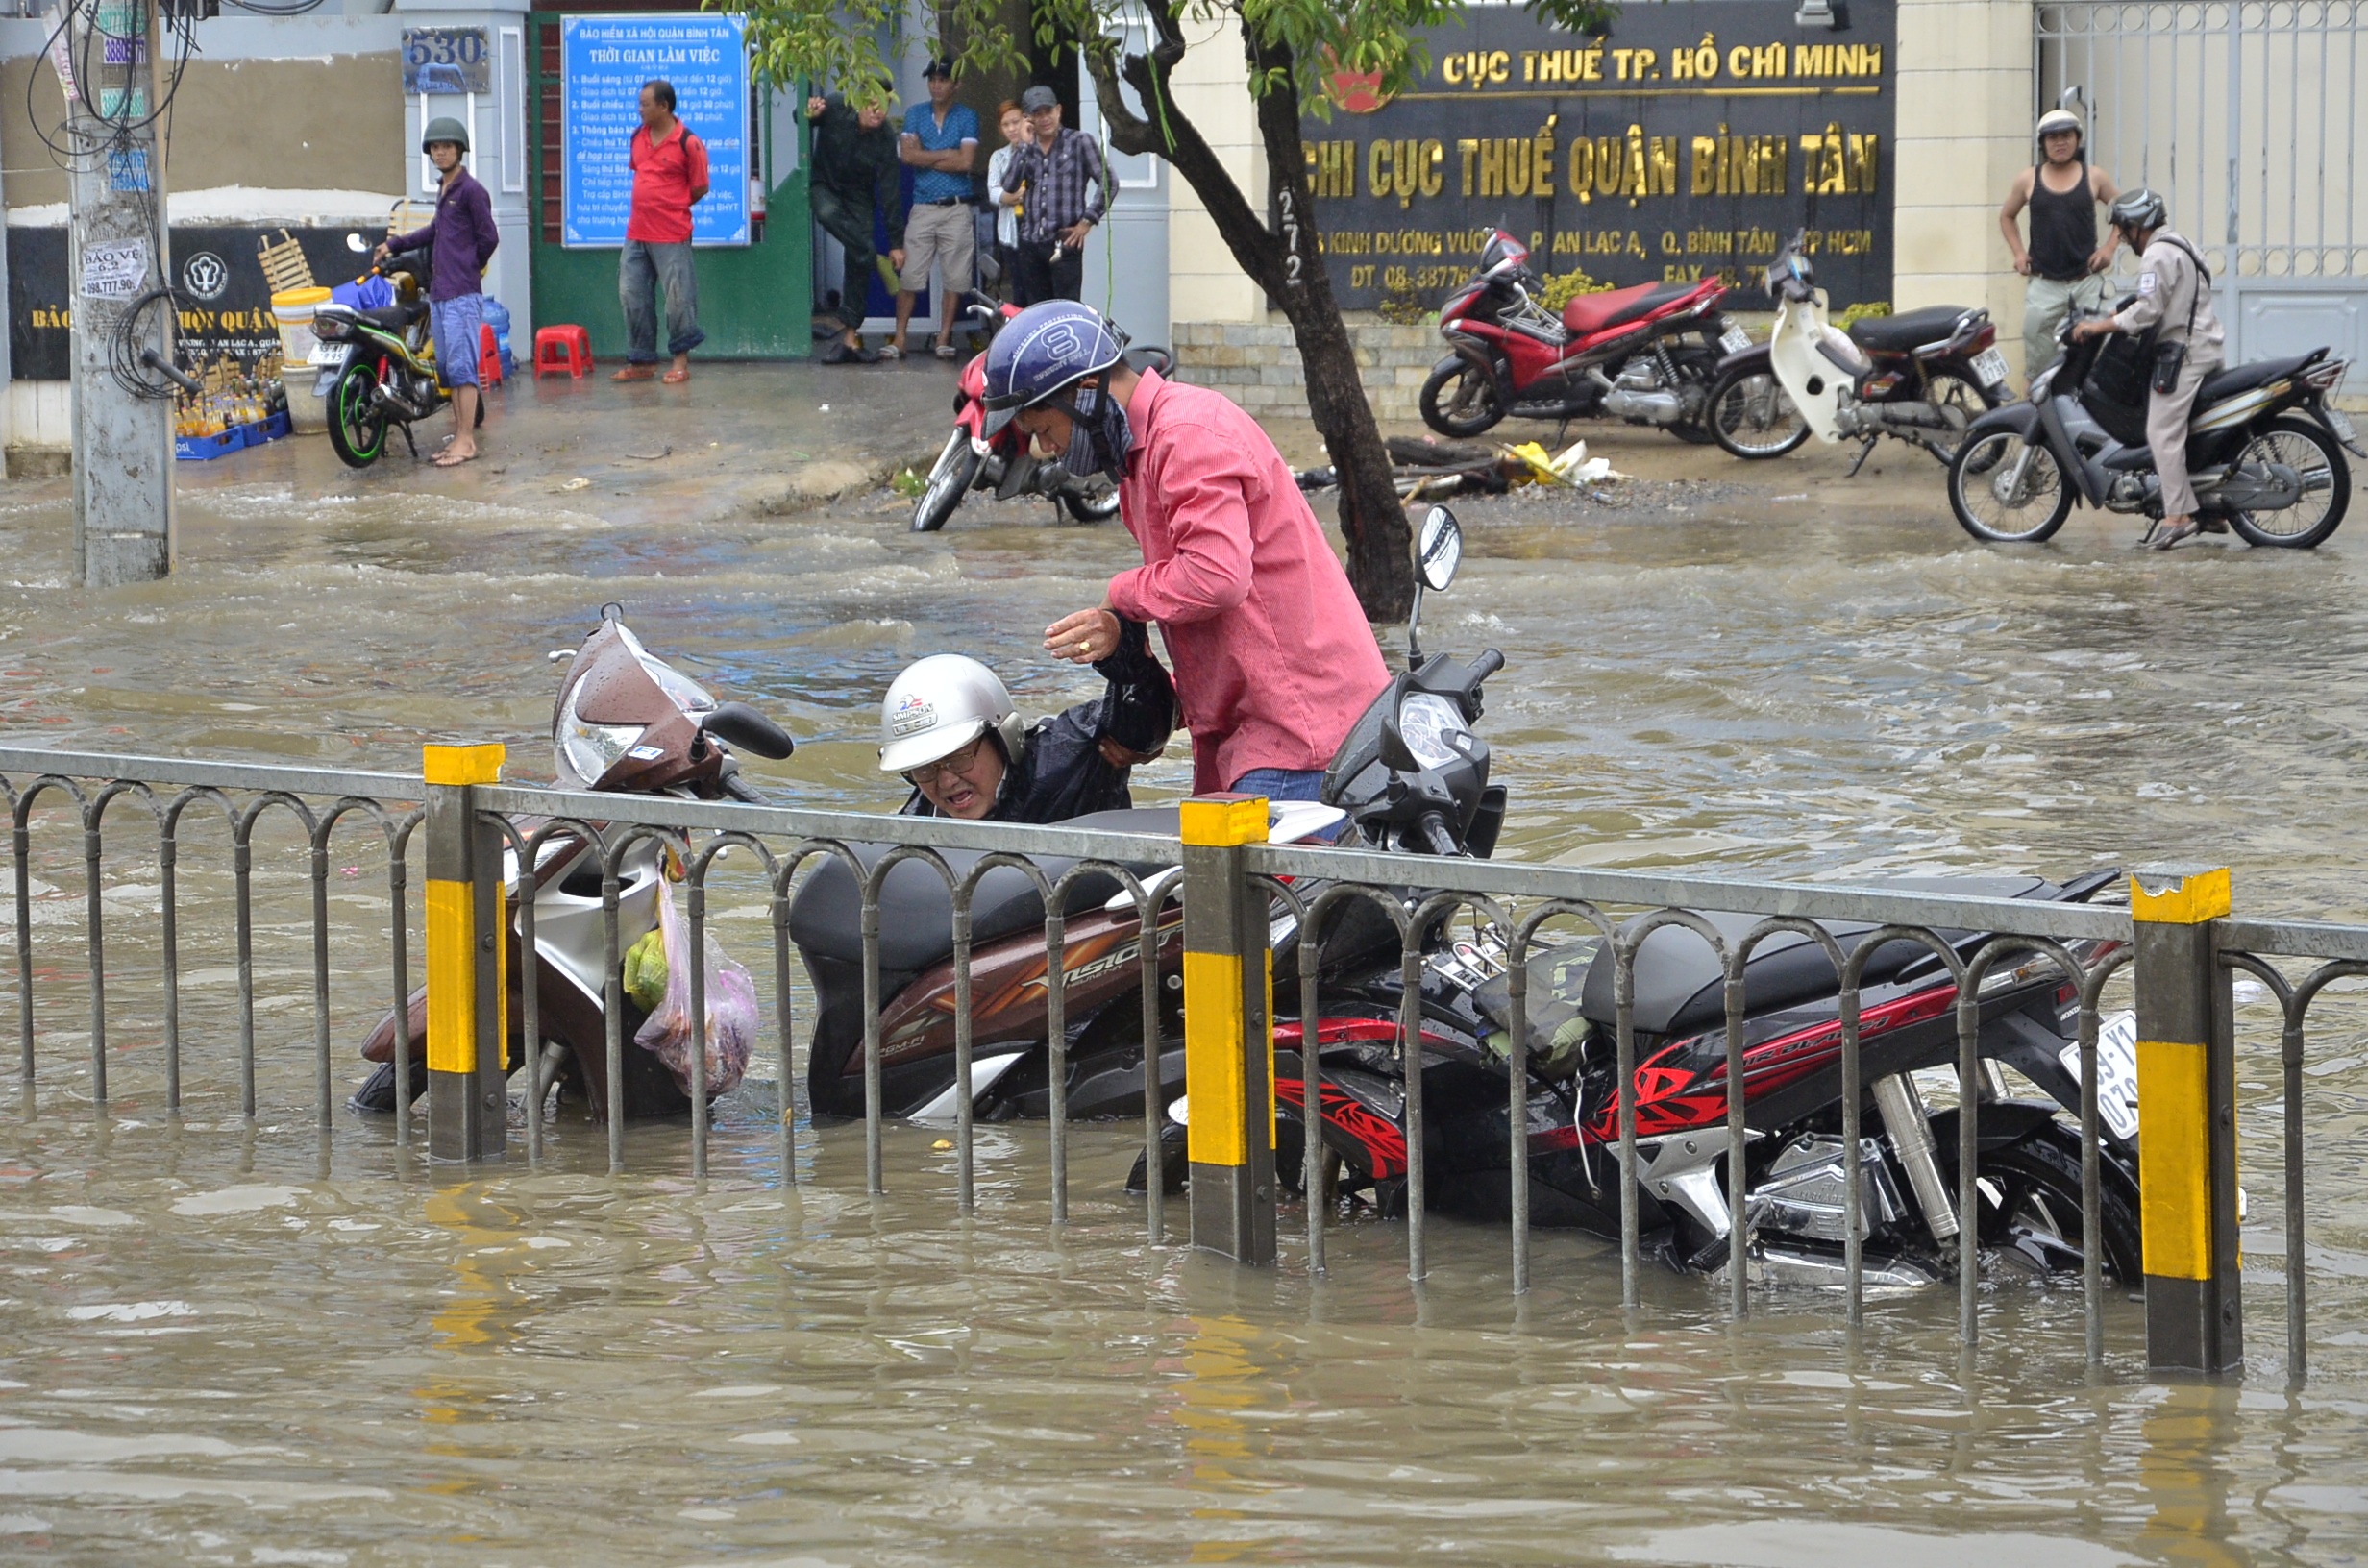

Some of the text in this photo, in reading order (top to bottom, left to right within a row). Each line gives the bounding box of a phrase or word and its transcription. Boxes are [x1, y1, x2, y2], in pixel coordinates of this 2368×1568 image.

[580, 25, 600, 39] BẢO
[601, 24, 624, 39] HIỂM
[640, 25, 656, 40] HỘI
[658, 25, 684, 40] QUẬN
[409, 31, 481, 65] 530
[589, 46, 721, 65] THỜI GIAN LÀM VIỆC
[1443, 51, 1510, 89] CỤC
[1520, 35, 1608, 82] THUẾ
[1613, 48, 1662, 80] TP.
[1672, 31, 1720, 80] HỒ
[1794, 44, 1882, 77] MINH
[1369, 138, 1443, 208] CỤC
[1457, 114, 1558, 197] THUẾ
[1569, 123, 1678, 208] QUẬN
[1691, 123, 1787, 196] BÌNH
[1800, 122, 1878, 195] TÂN
[1328, 232, 1371, 254] KINH
[1552, 231, 1581, 254] AN
[1662, 231, 1682, 255] Q.
[1687, 225, 1731, 255] BÌNH
[1736, 225, 1777, 255] TÂN
[1828, 230, 1872, 254] HCM
[176, 441, 190, 453] psi
[892, 702, 934, 722] SIMPSON
